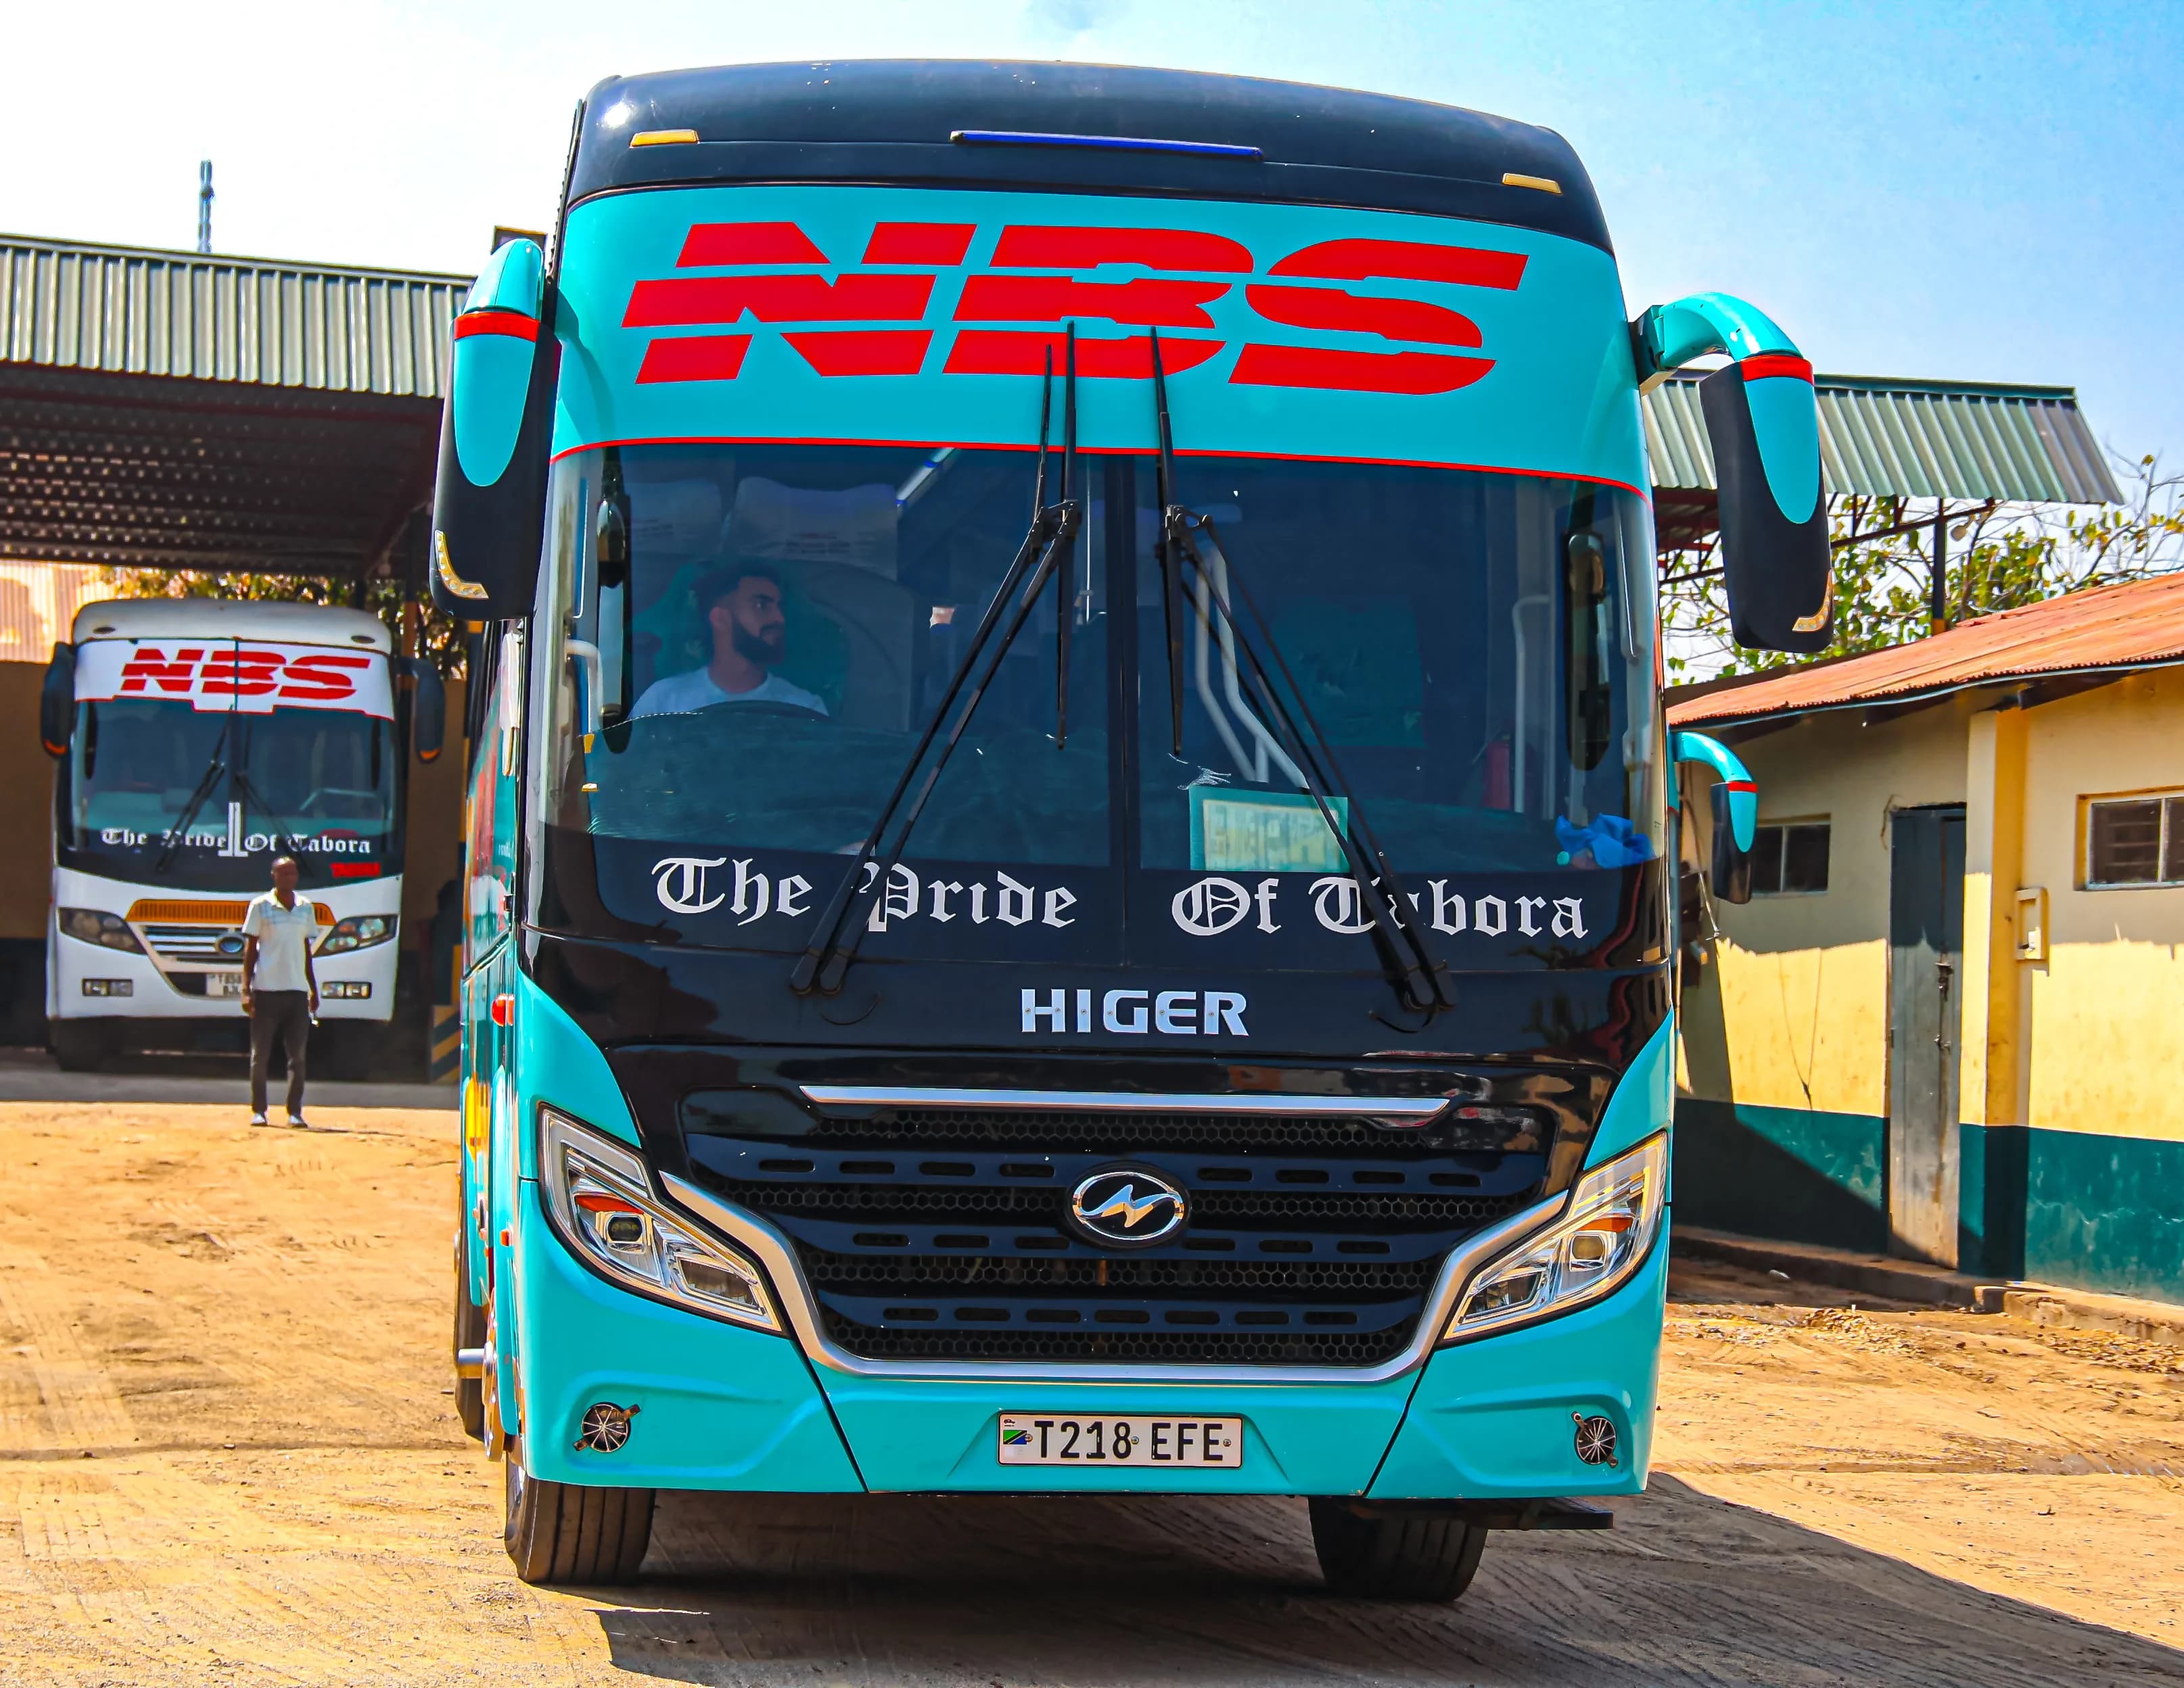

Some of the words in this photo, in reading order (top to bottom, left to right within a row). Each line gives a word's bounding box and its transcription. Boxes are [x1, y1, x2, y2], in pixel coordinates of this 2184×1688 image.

[622, 221, 1529, 395] NBS
[120, 648, 371, 701] NBS
[101, 827, 148, 847] The
[244, 833, 277, 852] Of
[287, 833, 371, 853] Tabora
[651, 857, 813, 927] The
[859, 861, 1077, 932] Pride
[1171, 877, 1282, 936] Of
[1021, 989, 1250, 1036] HIGER
[1034, 1421, 1132, 1459] T218
[1151, 1422, 1224, 1461] EFE
